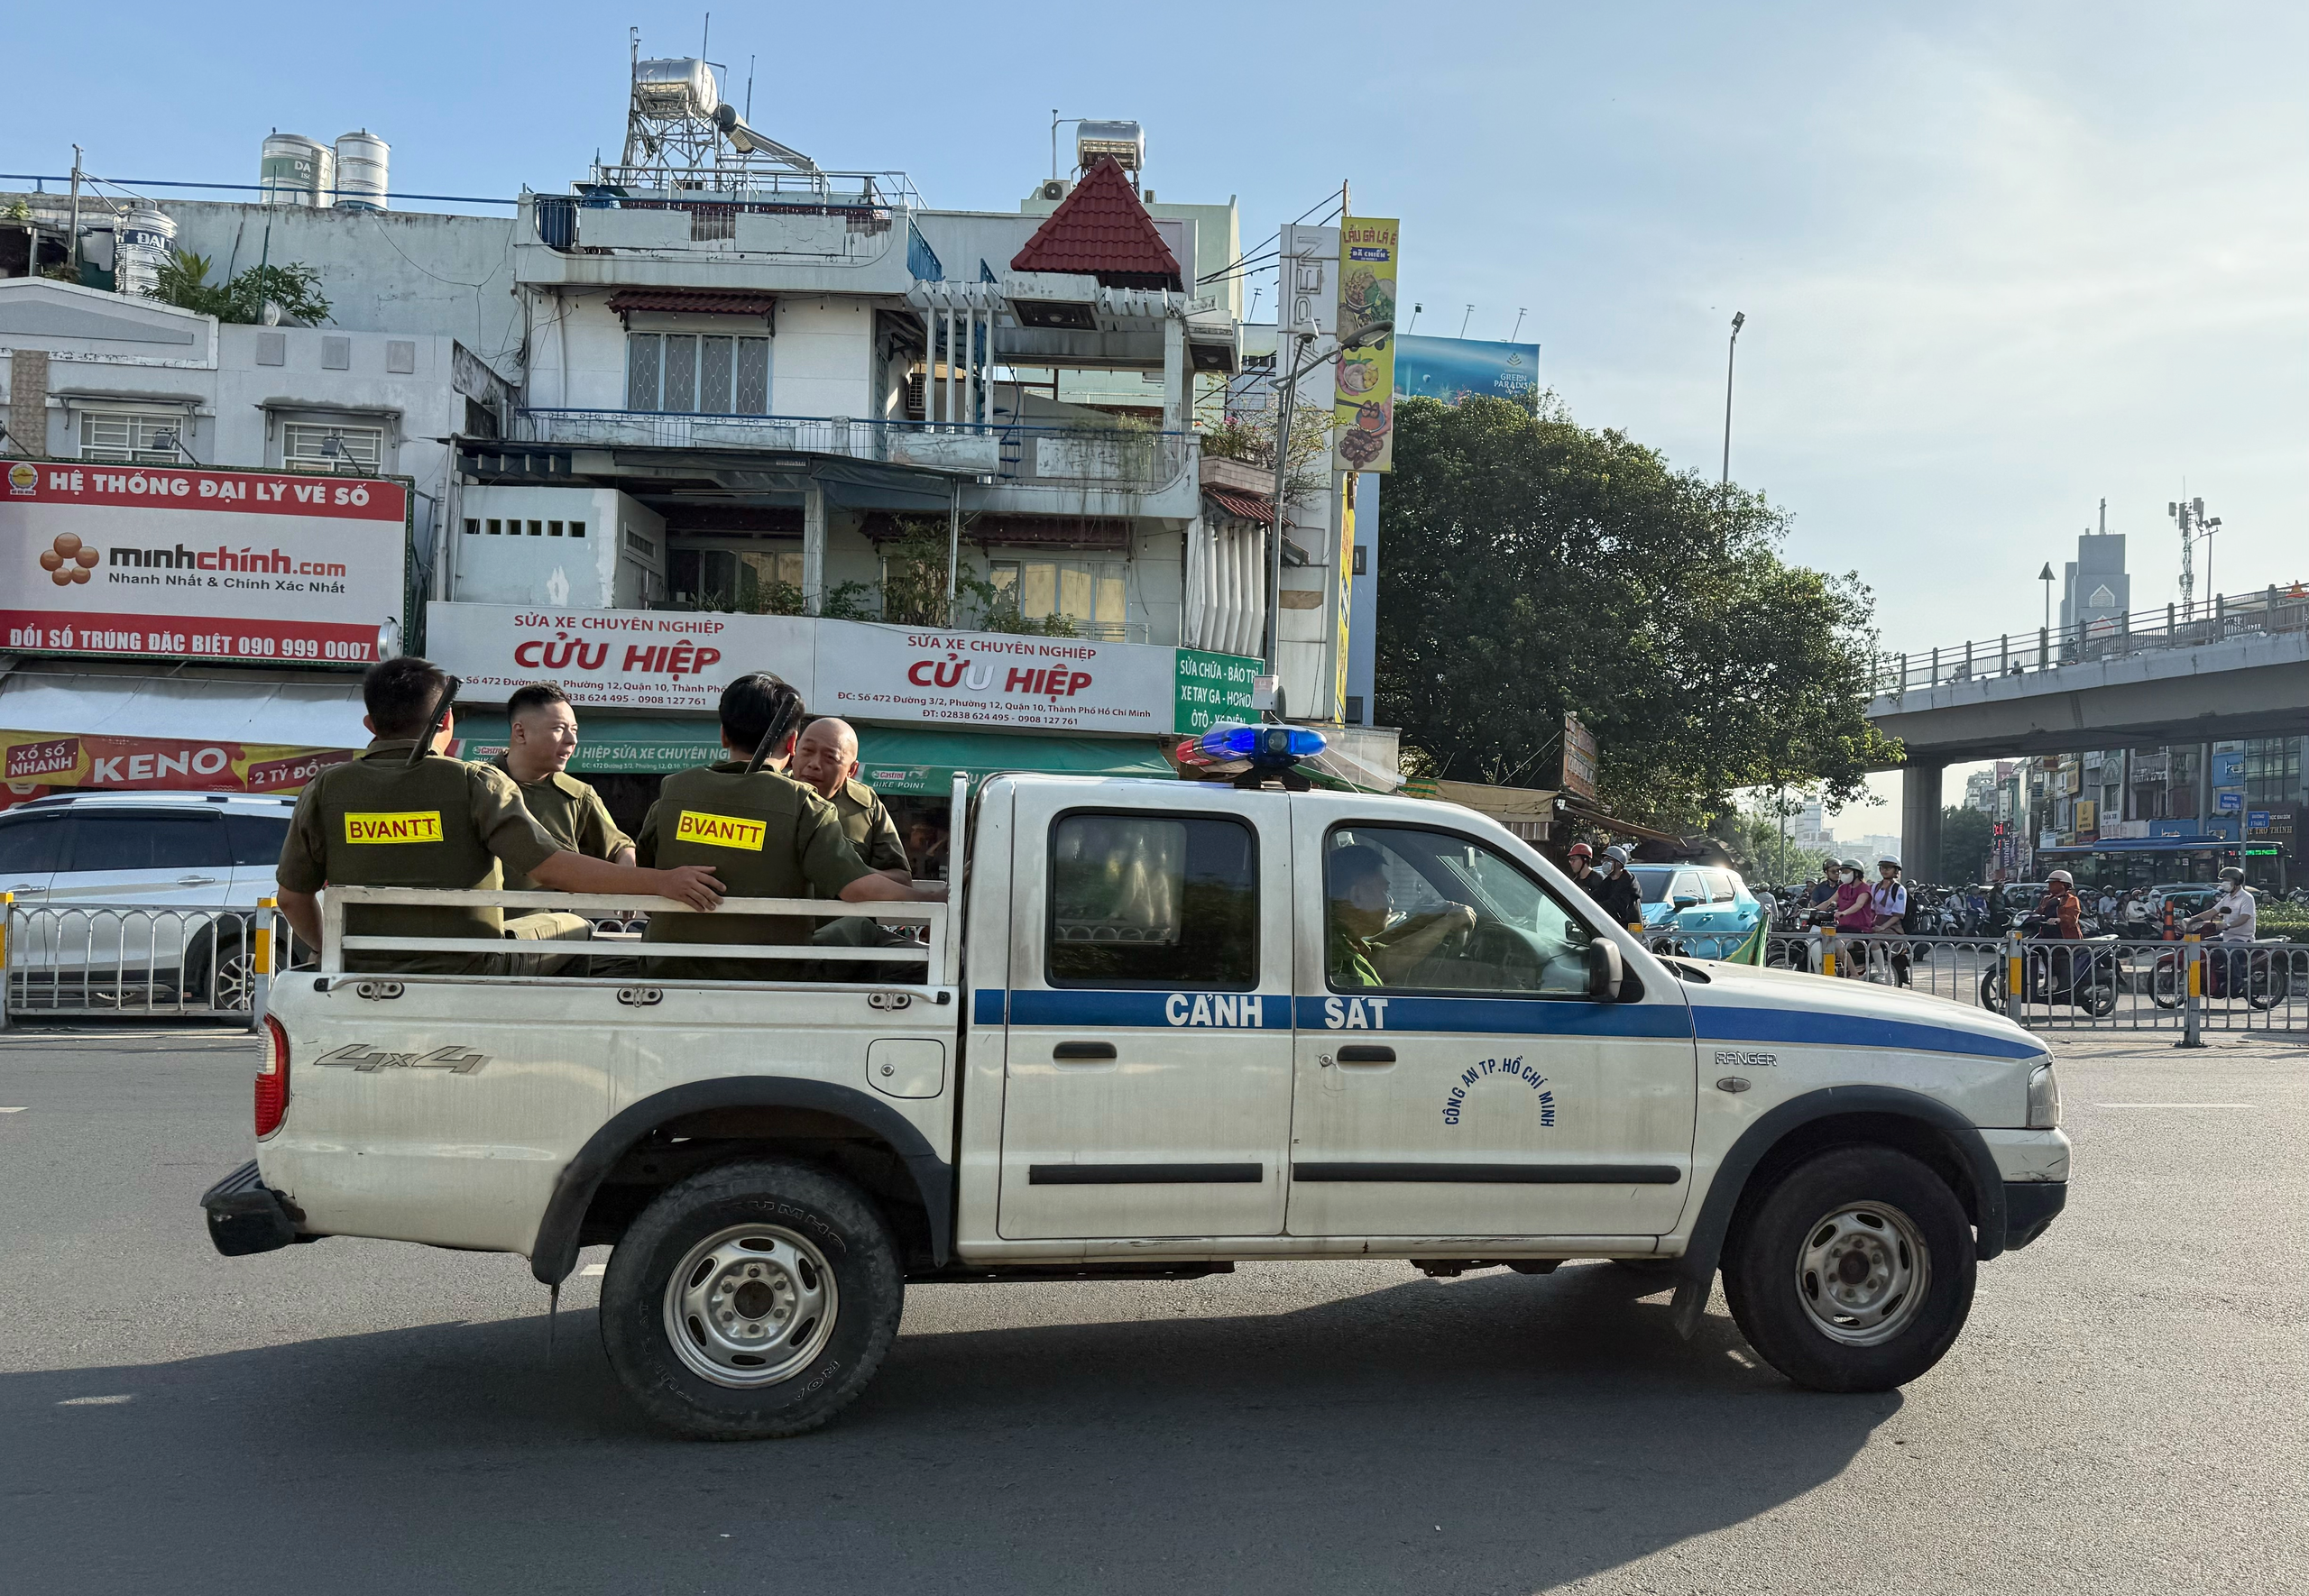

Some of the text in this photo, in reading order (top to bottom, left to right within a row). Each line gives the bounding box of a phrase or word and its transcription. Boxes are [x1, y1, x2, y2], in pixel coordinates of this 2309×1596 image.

[1363, 226, 1375, 243] GÀ
[1376, 228, 1388, 244] LÁ
[1500, 372, 1527, 381] GREEN
[50, 469, 370, 507] HỆ THỐNG ĐẠI LÝ VÉ SỐ
[108, 573, 345, 593] Nhanh Nhất & Chính Xác Nhất
[514, 611, 724, 637] SỬA XE CHUYÊN NGHIỆP
[9, 622, 371, 660] ĐỔI SỐ TRÚNG ĐẶC BIỆT 090 999 0007
[907, 633, 1097, 662] SỬA XE CHUYÊN NGHIỆP
[514, 631, 721, 682] CỬU HIỆP
[907, 652, 1093, 703] CỬU HIỆP
[1180, 656, 1197, 676] SỬA
[1199, 660, 1222, 680] CHỮA
[1228, 663, 1245, 683] BẢO
[465, 675, 480, 684] Số
[482, 677, 501, 685] 472
[563, 680, 604, 691] Phường
[623, 682, 651, 693] Quận
[655, 683, 669, 693] 10,
[672, 683, 704, 693] Thành
[1181, 685, 1191, 701] XE
[1193, 686, 1208, 702] TAY
[1209, 689, 1221, 704] GA
[587, 693, 607, 702] 624
[610, 694, 629, 702] 495
[638, 695, 664, 704] 0908
[667, 697, 685, 705] 127
[688, 697, 706, 705] 761
[838, 692, 855, 701] ĐC:
[858, 693, 870, 702] Số
[872, 694, 891, 702] 472
[893, 695, 926, 706] Đường
[929, 697, 947, 707] 3/2,
[949, 698, 987, 710] Phường
[989, 702, 1003, 710] 12,
[1005, 702, 1030, 712] Quận
[1033, 703, 1045, 712] 10,
[1048, 704, 1076, 714] Thành
[1078, 705, 1096, 715] Phố
[1112, 708, 1127, 717] Chí
[1128, 709, 1151, 718] Minh
[923, 709, 938, 718] ĐT:
[941, 711, 971, 719] 02838
[972, 712, 989, 720] 624
[992, 713, 1009, 721] 495
[1018, 715, 1041, 723] 0908
[1044, 716, 1060, 724] 127
[1062, 717, 1078, 725] 761
[1191, 709, 1209, 728] ÔTÔ
[16, 741, 66, 761] XỔ SỐ
[582, 745, 612, 761] HIỆP
[612, 744, 638, 759] SỬA
[639, 748, 655, 759] XE
[657, 746, 707, 759] CHUYÊN
[10, 757, 72, 775] NHANH
[93, 748, 227, 783] KENO
[254, 771, 265, 784] 2
[269, 765, 289, 782] TỶ
[350, 818, 436, 839] BVANTT
[680, 815, 762, 843] BVANTT
[1165, 993, 1388, 1030] CẢNH SÁT
[313, 1043, 492, 1075] 4x4
[1715, 1050, 1777, 1067] RANGER
[1442, 1087, 1466, 1125] CÔNG
[1461, 1067, 1480, 1087] AN
[1522, 1066, 1549, 1089] CHÍ
[1538, 1090, 1555, 1127] MINH
